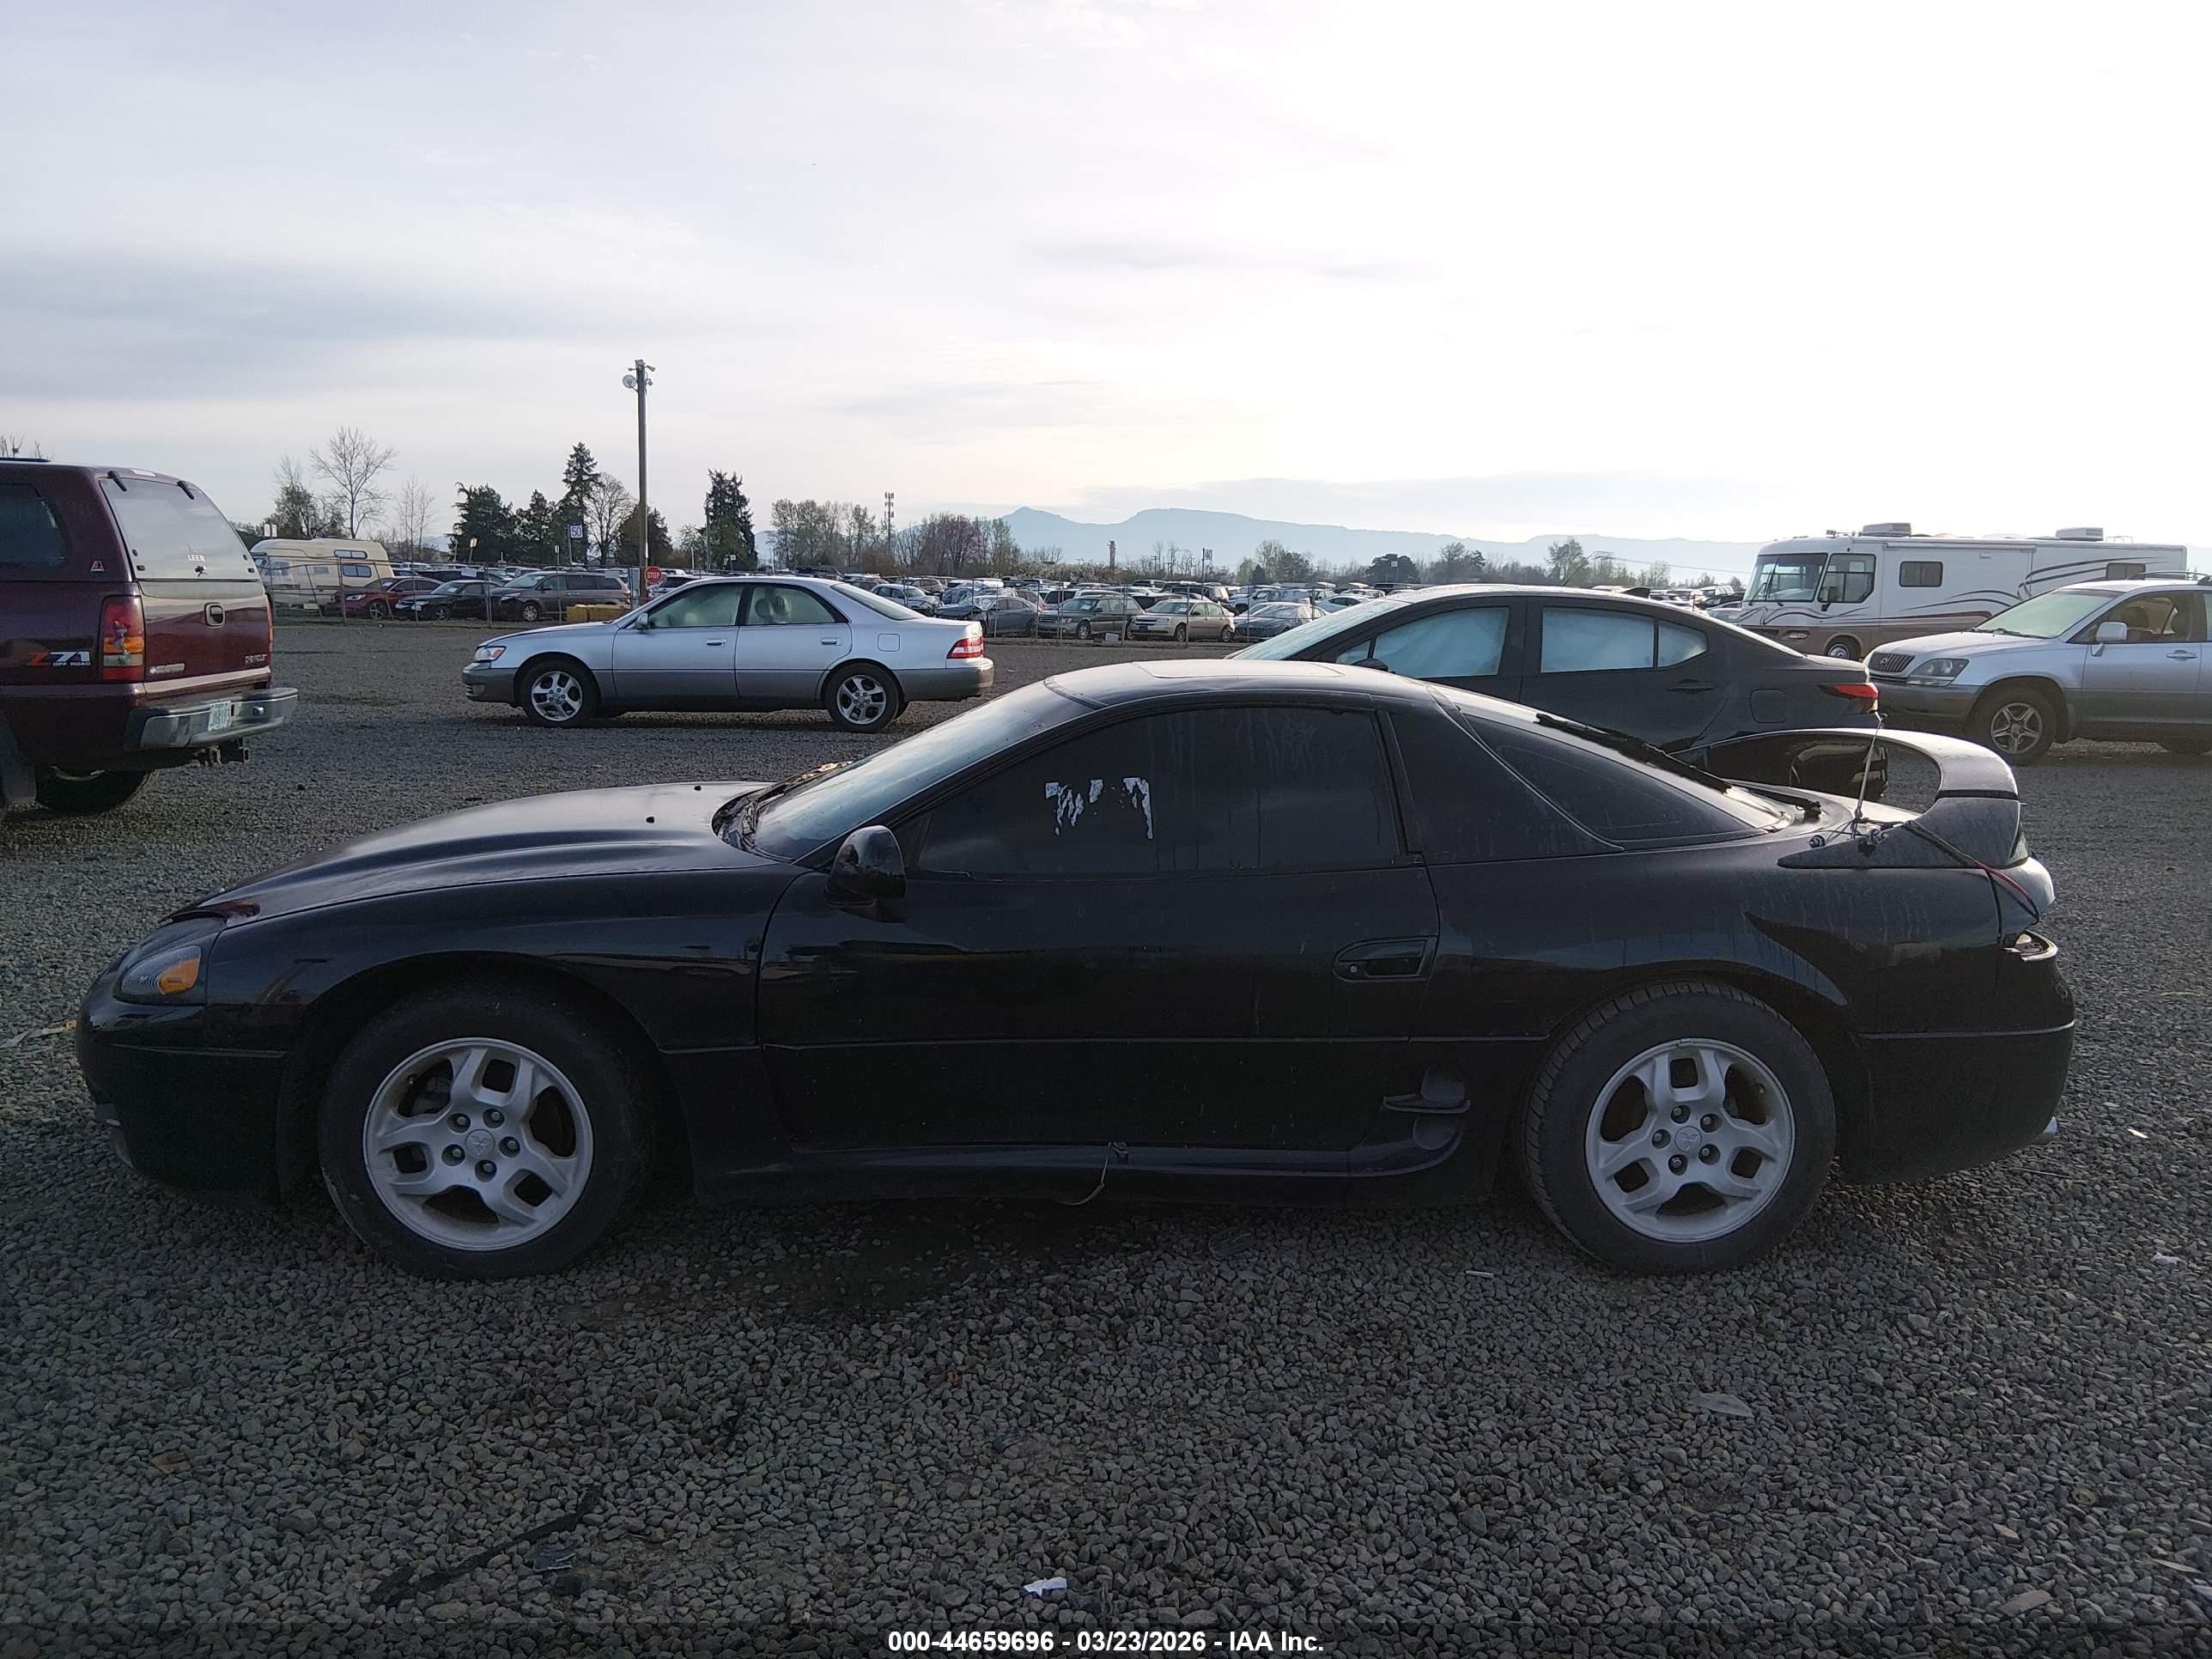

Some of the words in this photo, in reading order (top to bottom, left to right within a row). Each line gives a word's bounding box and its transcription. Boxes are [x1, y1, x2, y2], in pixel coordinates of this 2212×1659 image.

[571, 526, 582, 537] 50
[187, 554, 206, 562] LEER
[646, 571, 660, 580] STOP
[27, 651, 90, 666] Z71
